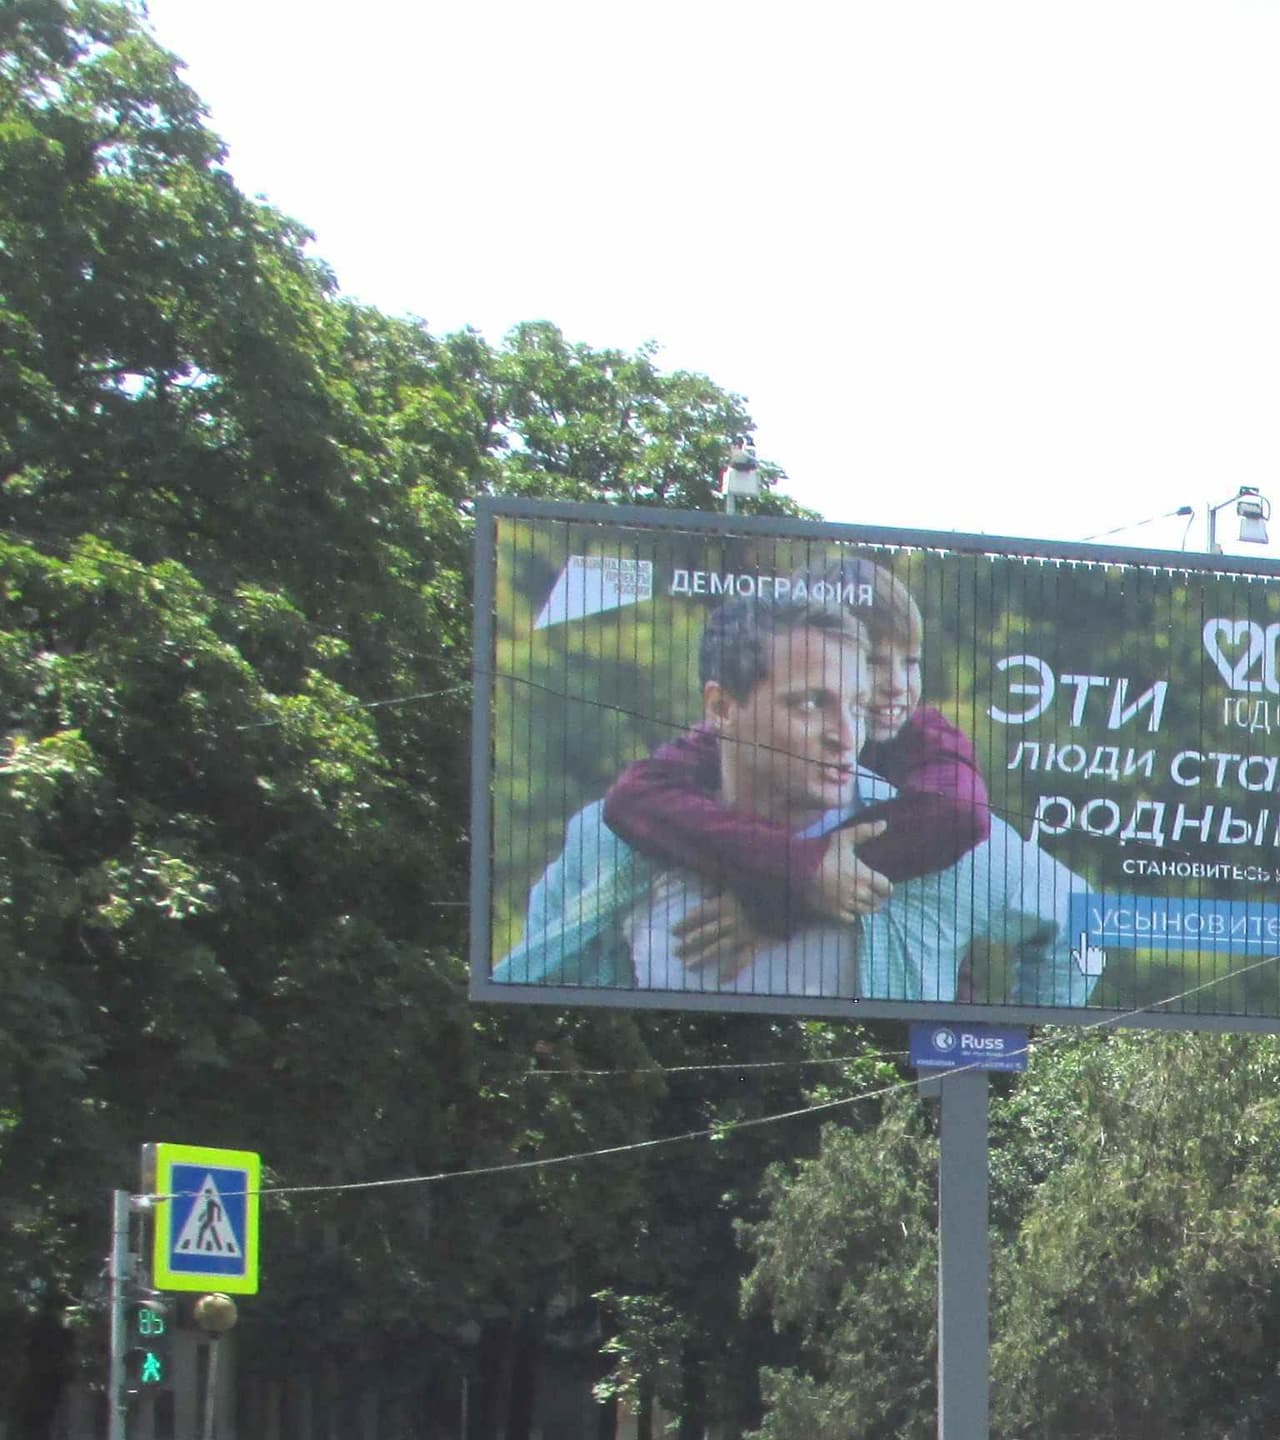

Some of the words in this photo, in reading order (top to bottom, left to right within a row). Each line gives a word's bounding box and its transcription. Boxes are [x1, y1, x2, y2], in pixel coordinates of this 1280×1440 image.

[671, 568, 874, 606] ДЕМОГРАФИЯ
[986, 654, 1168, 732] Эти
[1007, 740, 1157, 782] люди
[1122, 858, 1270, 883] СТАНОВИТЕСЬ
[960, 1033, 1005, 1051] Russ
